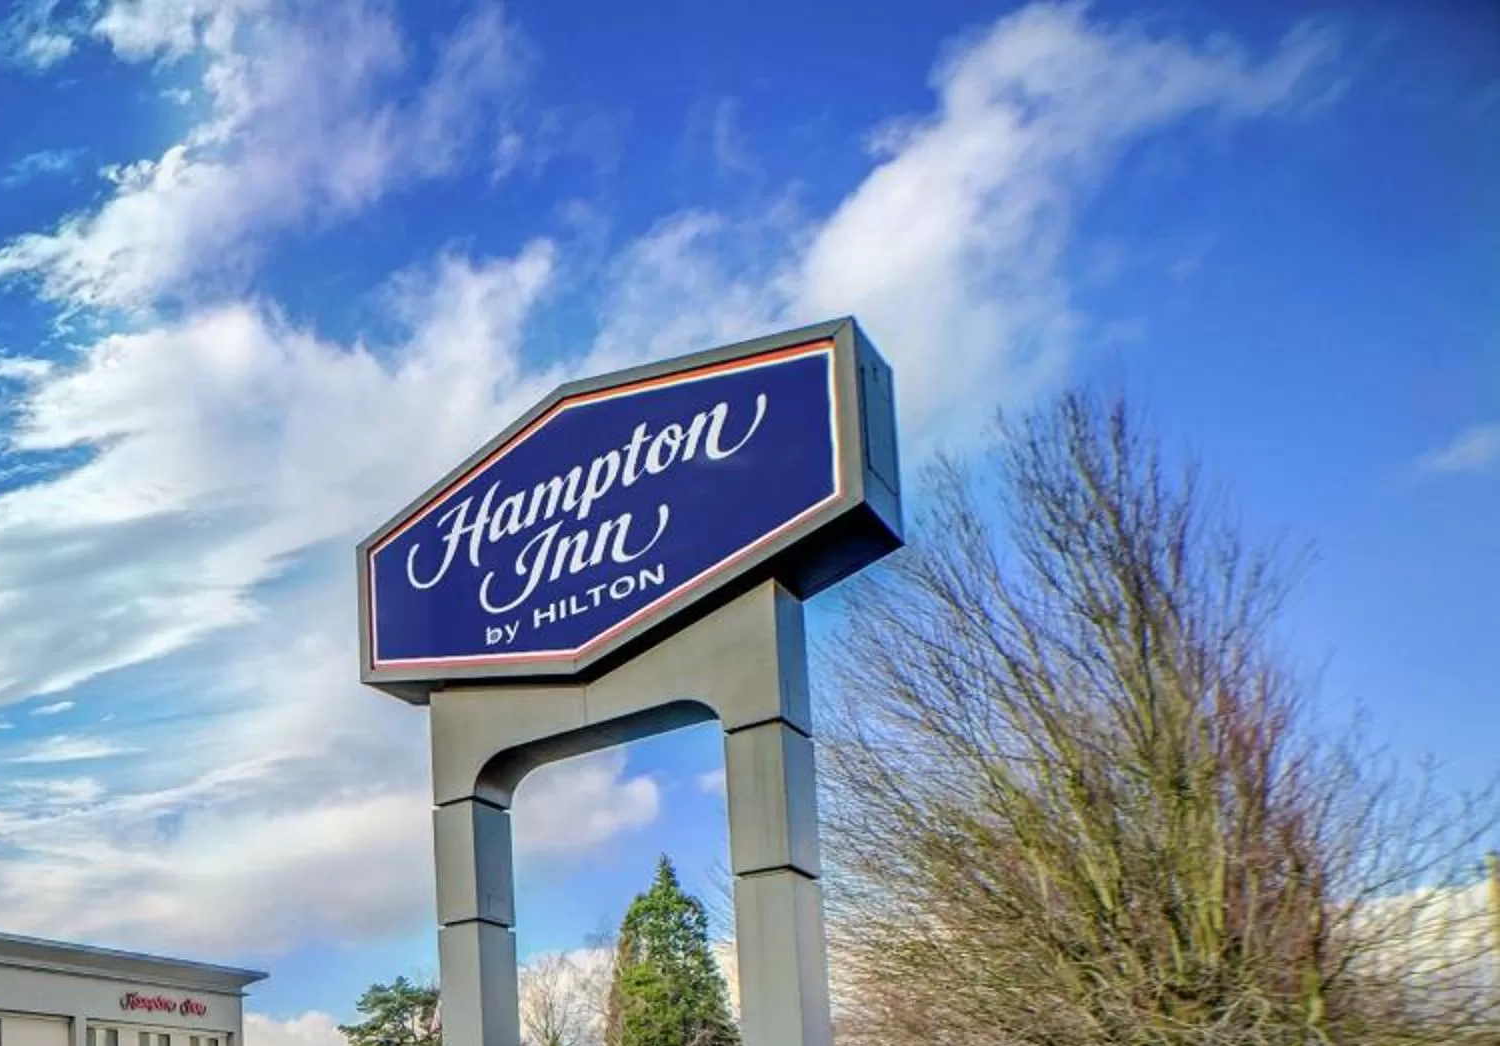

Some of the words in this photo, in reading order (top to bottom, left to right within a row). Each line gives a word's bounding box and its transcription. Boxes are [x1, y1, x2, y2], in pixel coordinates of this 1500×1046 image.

[407, 393, 767, 589] Hampton
[479, 503, 669, 614] Inn
[485, 621, 520, 645] by
[533, 563, 665, 628] HILTON
